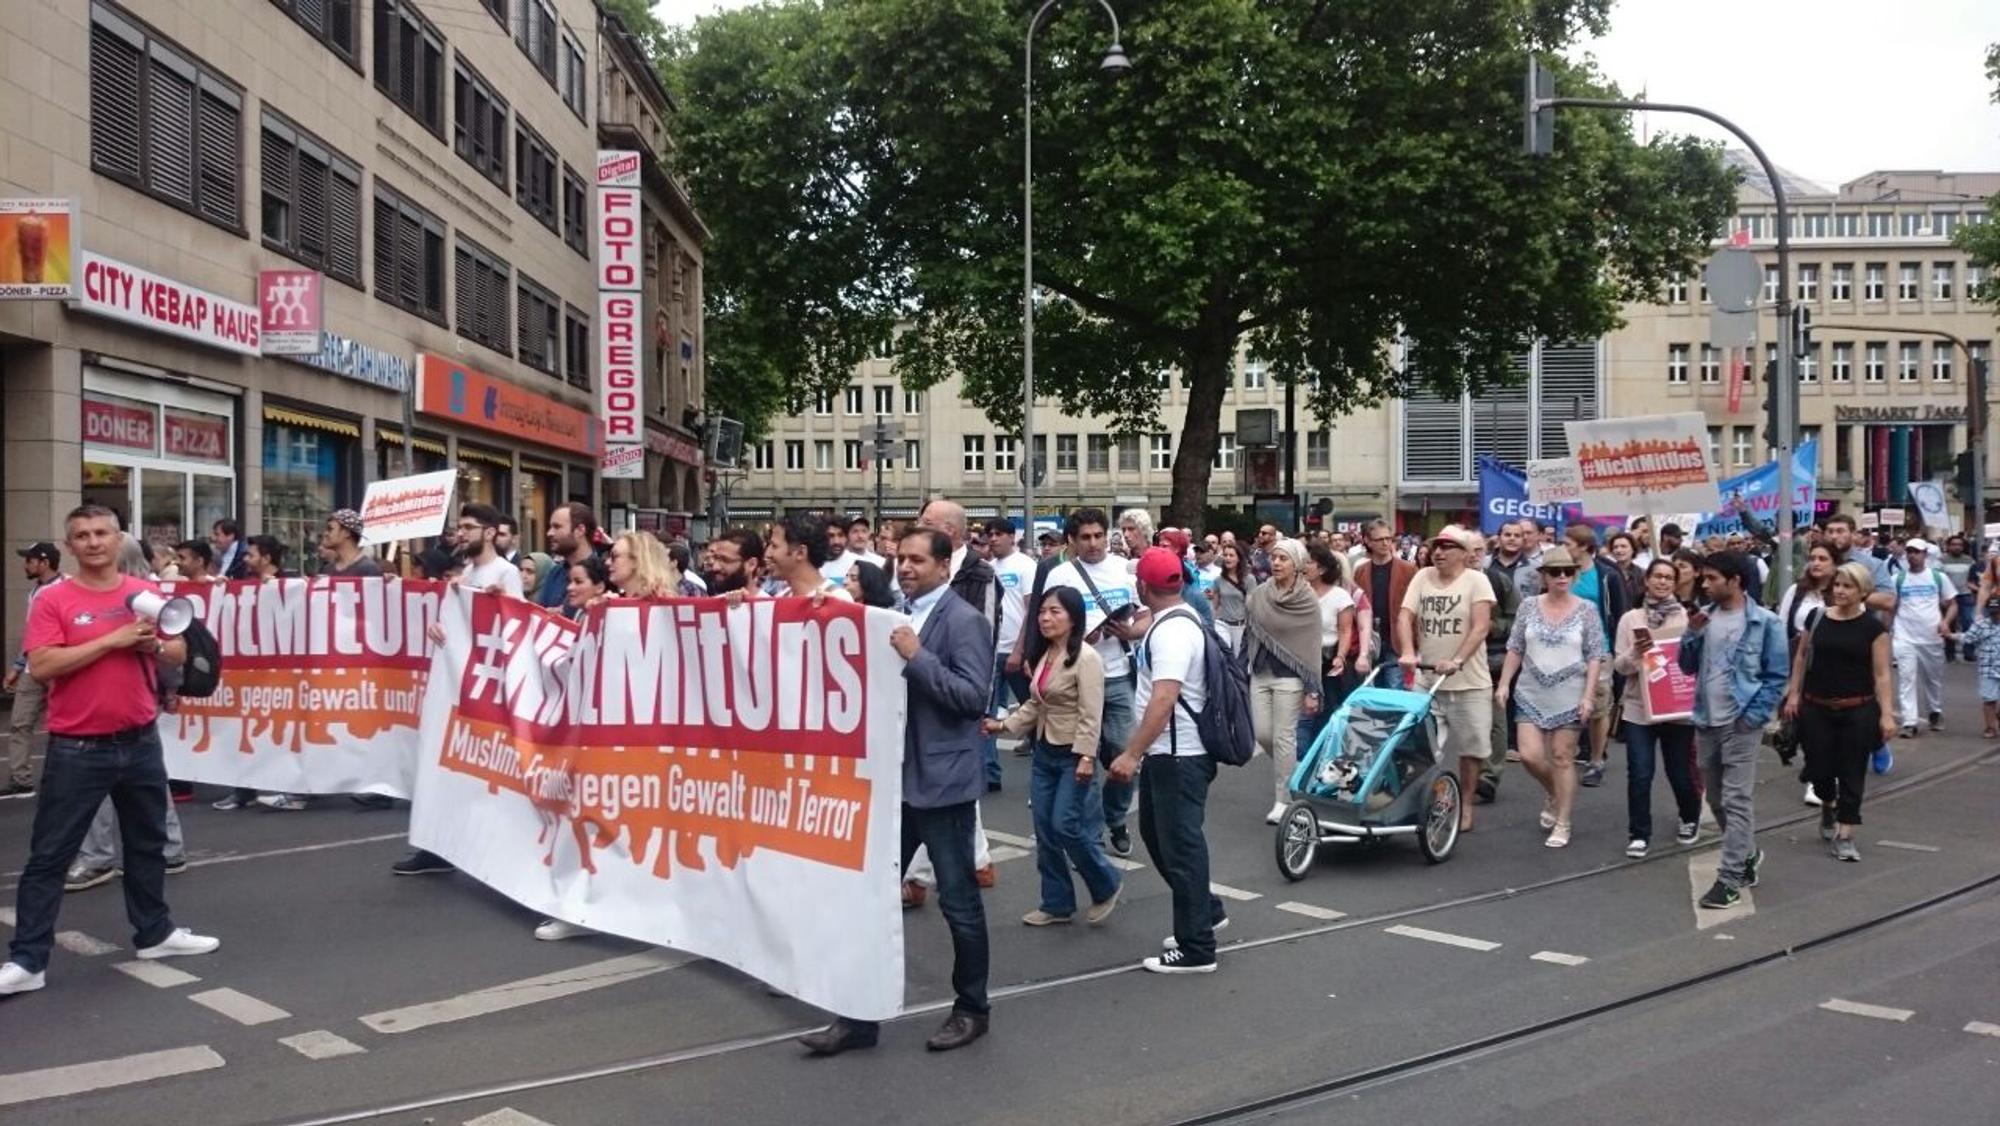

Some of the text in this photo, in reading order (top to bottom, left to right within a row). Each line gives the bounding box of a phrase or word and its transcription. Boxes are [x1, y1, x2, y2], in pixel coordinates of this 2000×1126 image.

[600, 158, 636, 178] Digital
[605, 193, 634, 285] FOTO
[39, 286, 68, 296] PIZZA
[85, 261, 259, 347] CITY KEBAP HAUS
[607, 299, 635, 435] GREGOR
[1835, 404, 1919, 419] NEUMARKT
[171, 425, 221, 455] PIZZA
[1582, 450, 1702, 478] #NichtMitUns
[240, 684, 293, 716] gegen
[298, 680, 378, 710] Gewalt
[384, 685, 417, 713] und
[668, 764, 746, 821] Gewalt
[751, 778, 793, 828] und
[799, 783, 861, 842] Terror
